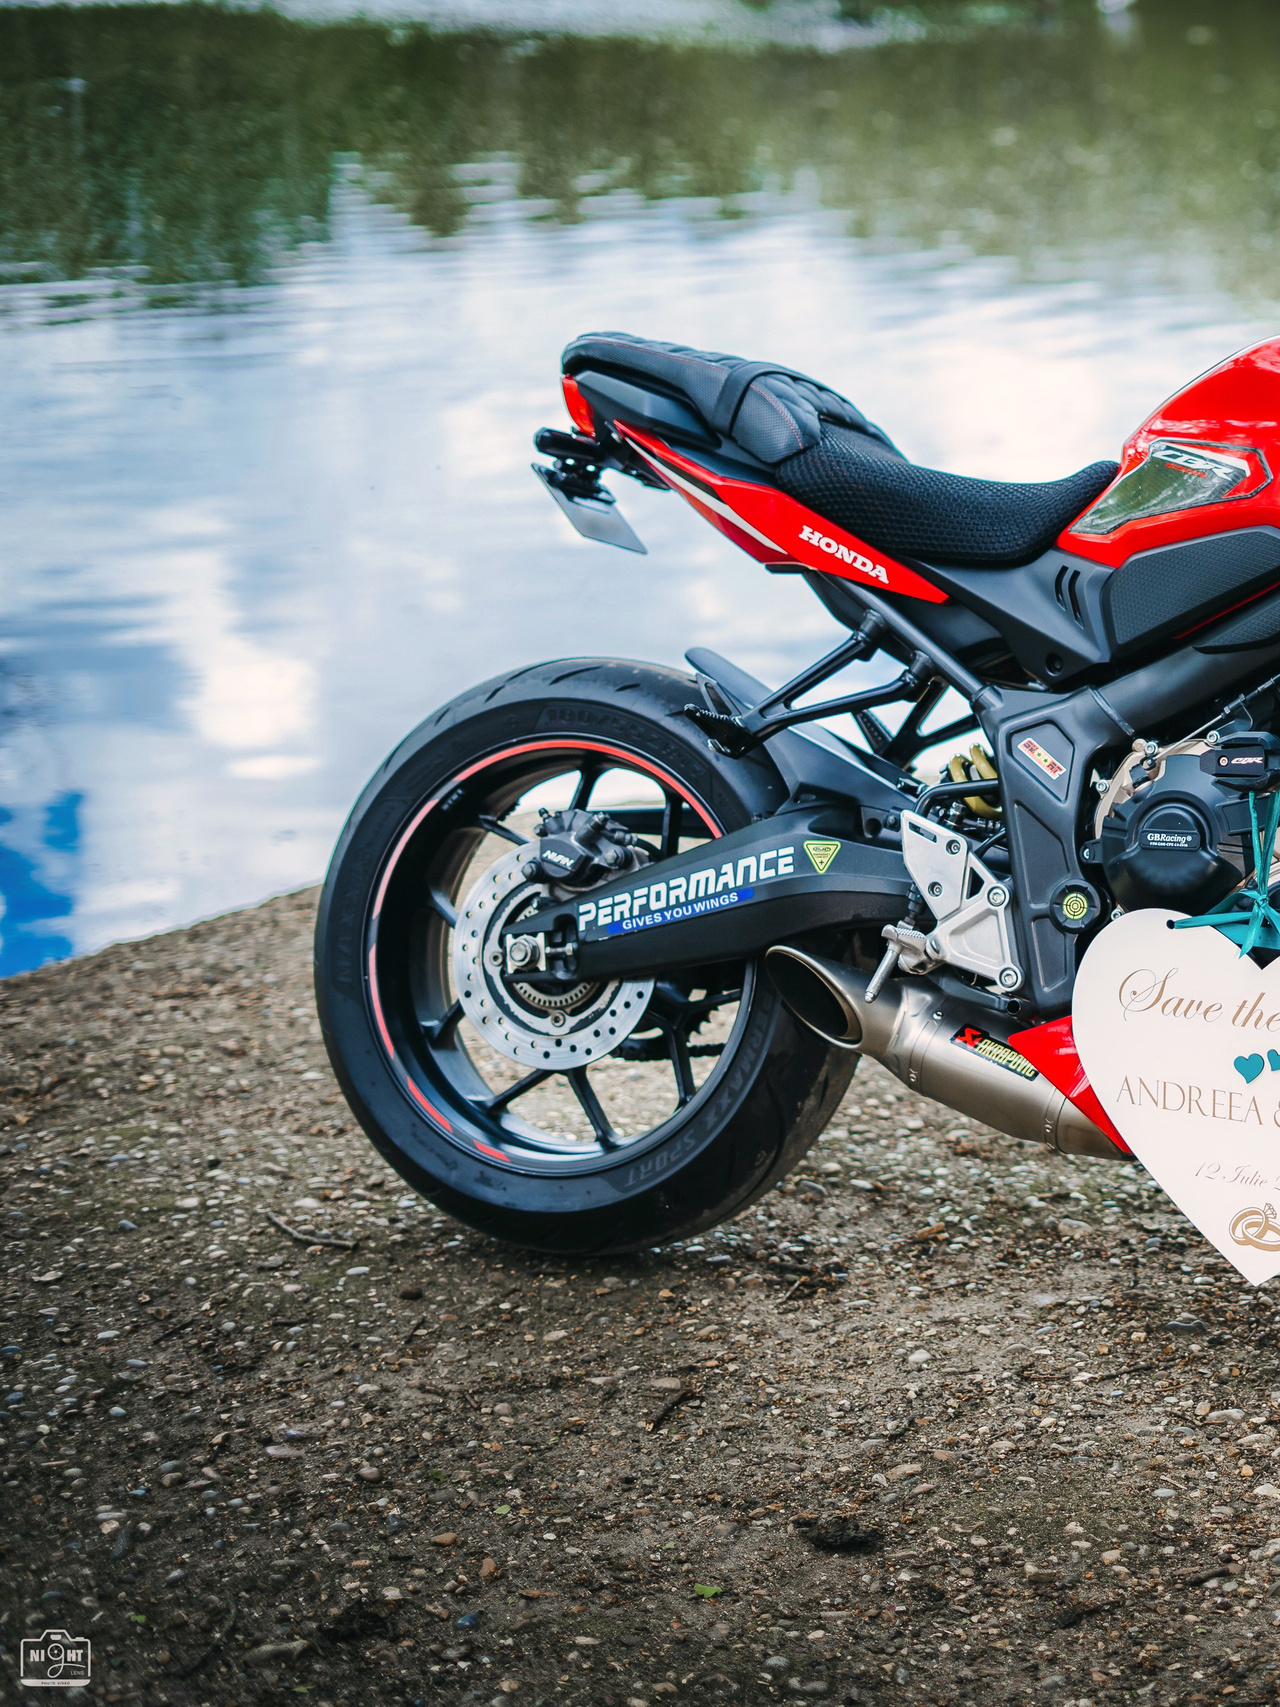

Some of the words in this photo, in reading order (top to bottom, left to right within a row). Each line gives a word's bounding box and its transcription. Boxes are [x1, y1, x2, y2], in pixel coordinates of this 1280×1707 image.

[798, 525, 889, 584] HONDA
[578, 846, 795, 932] PERFORMANCE
[622, 912, 663, 930] GIVES
[663, 904, 693, 922] YOU
[692, 892, 739, 913] WINGS
[1118, 967, 1224, 1022] Save
[1116, 1075, 1264, 1126] ANDREEA
[624, 1129, 697, 1187] SPORT
[1195, 1161, 1221, 1178] 12
